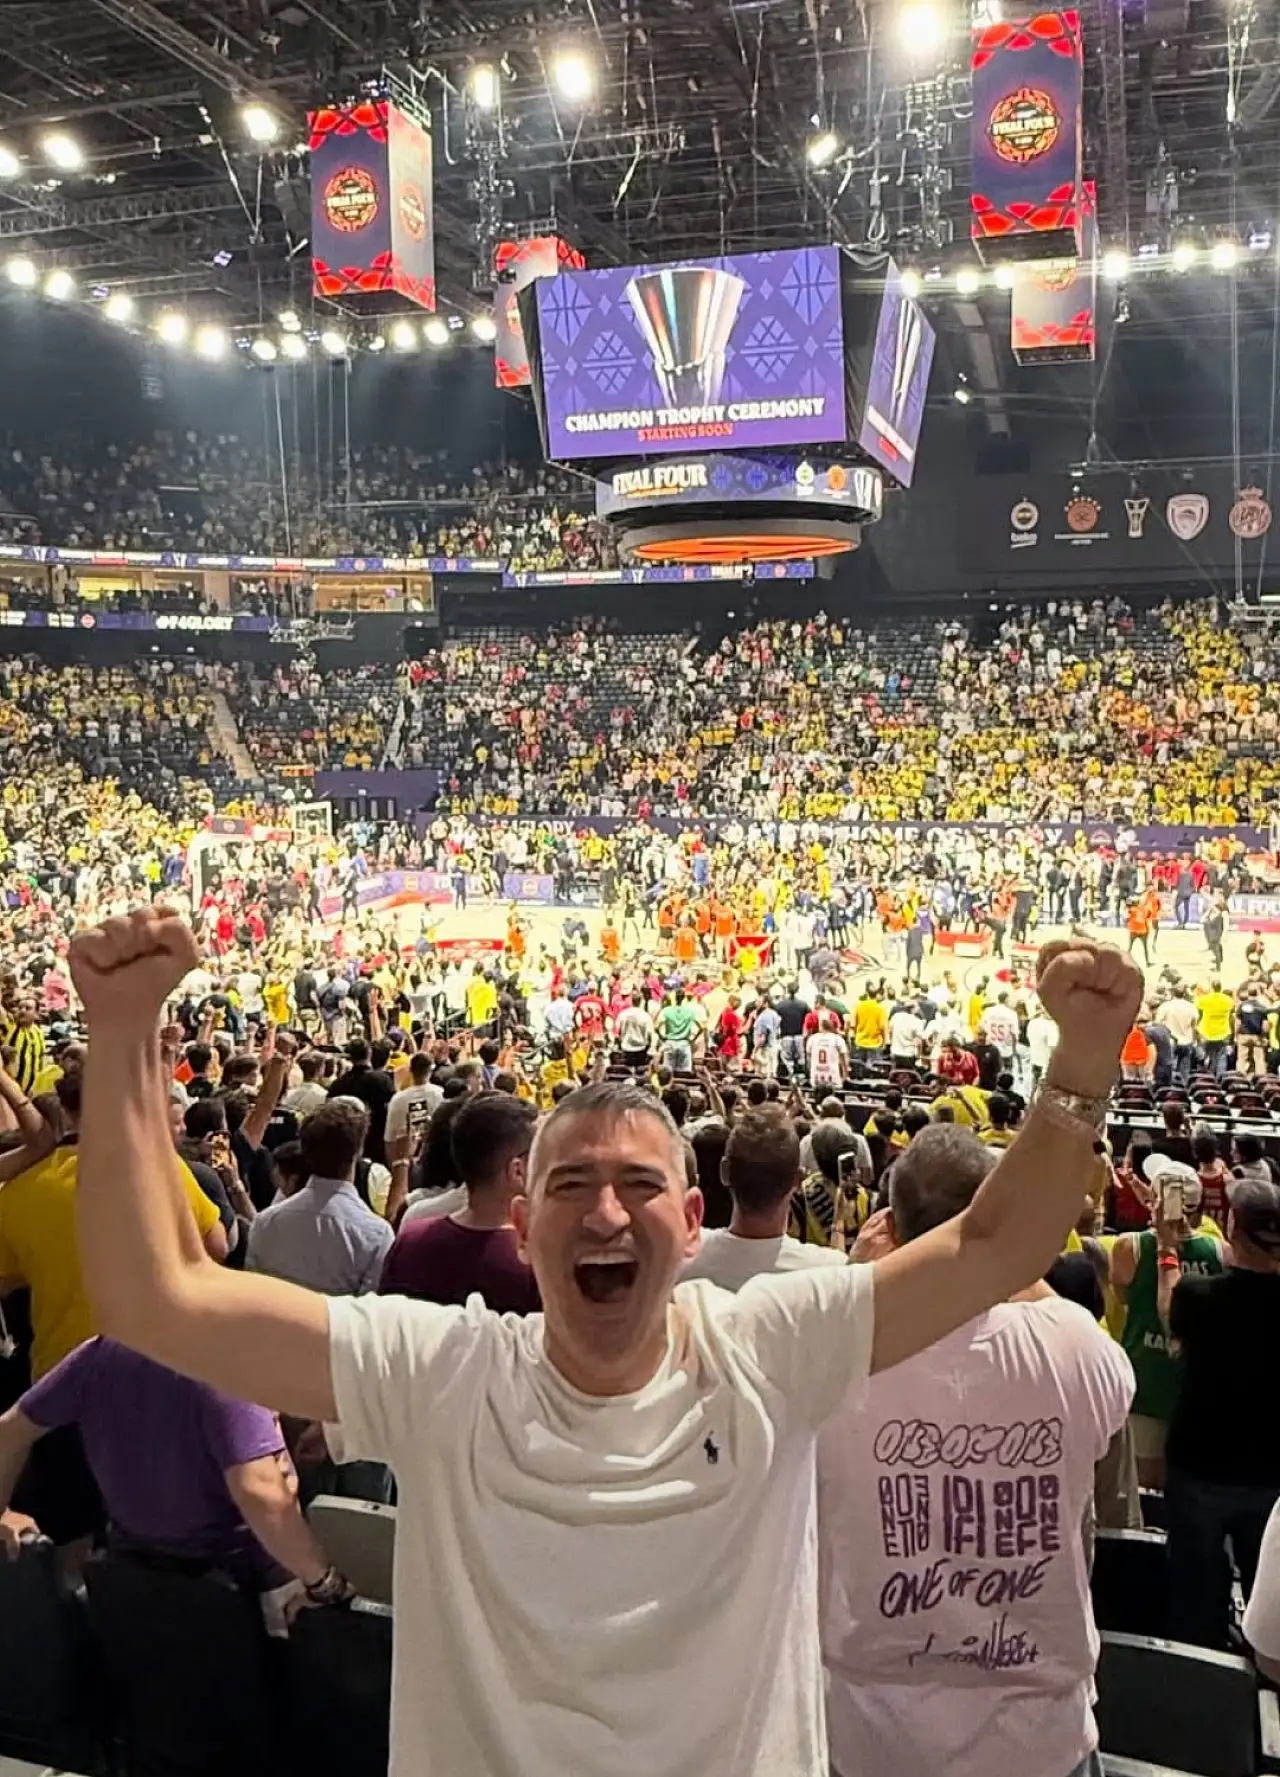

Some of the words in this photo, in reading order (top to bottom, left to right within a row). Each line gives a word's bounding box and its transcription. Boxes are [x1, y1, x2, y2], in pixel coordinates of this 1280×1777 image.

[565, 410, 653, 432] CHAMPION
[656, 405, 725, 425] TROPHY
[727, 397, 825, 421] CEREMONY
[638, 425, 697, 441] STARTING
[697, 422, 735, 438] SOON
[653, 463, 708, 488] FOUR
[880, 1558, 950, 1618] ONE
[949, 1568, 981, 1597] OF
[976, 1556, 1054, 1607] ONE
